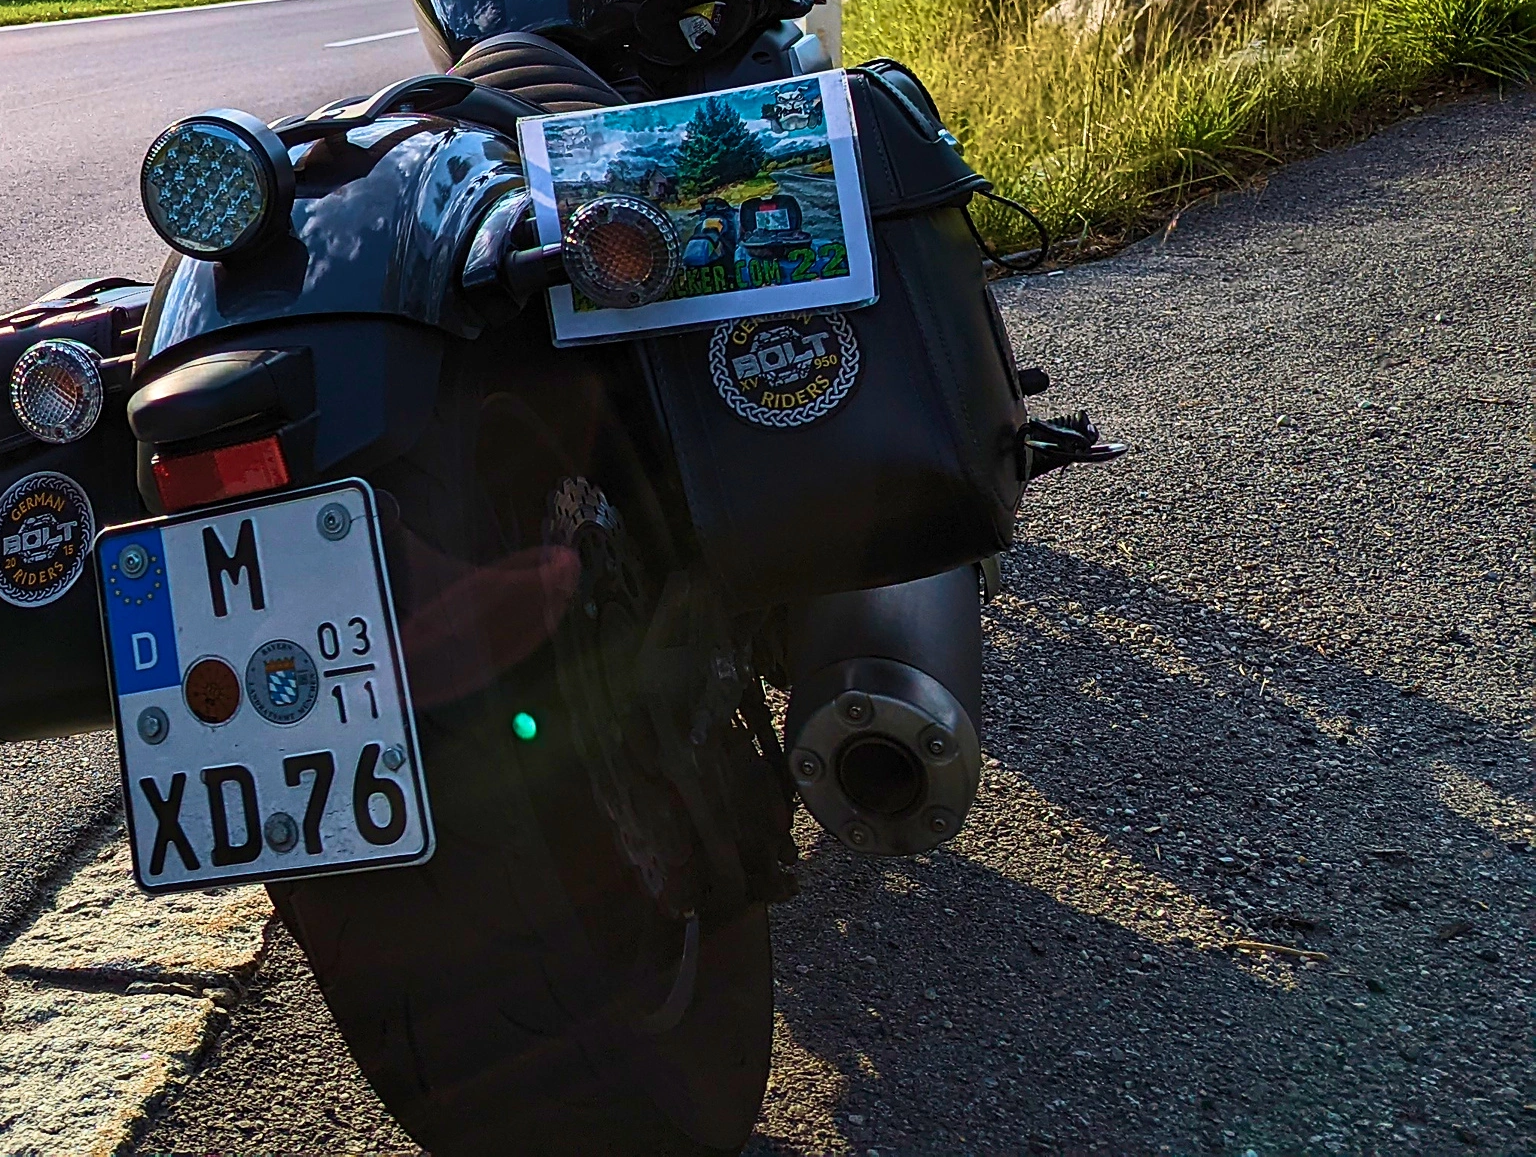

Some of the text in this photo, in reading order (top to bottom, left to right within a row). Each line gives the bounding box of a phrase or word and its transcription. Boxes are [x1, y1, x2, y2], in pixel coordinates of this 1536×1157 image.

[787, 243, 848, 282] 22
[731, 331, 830, 380] BOLT
[740, 354, 838, 392] XV 950
[761, 374, 830, 408] RIDERS
[11, 492, 66, 521] GERMAN
[2, 520, 78, 556] BOLT
[4, 557, 17, 570] 20
[13, 561, 64, 585] RIDERS
[202, 518, 265, 617] M
[131, 631, 158, 672] D
[316, 616, 372, 661] 03
[331, 680, 378, 724] 11
